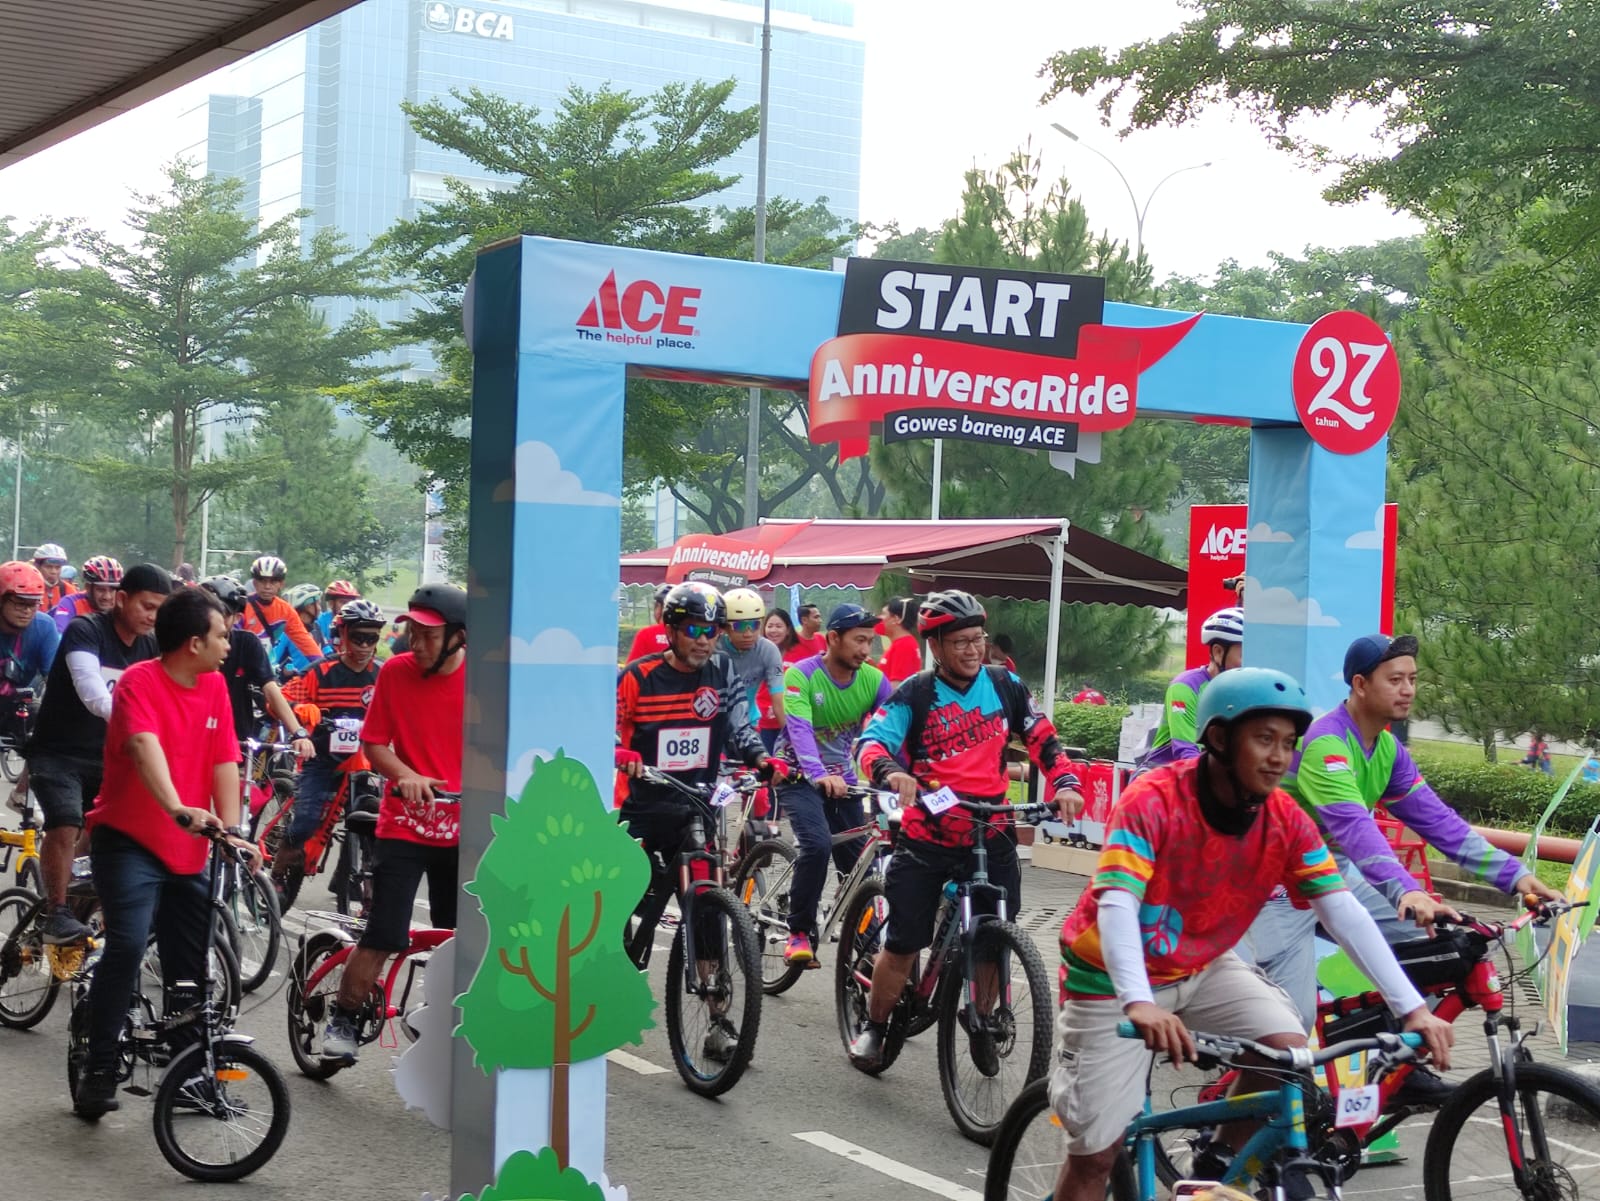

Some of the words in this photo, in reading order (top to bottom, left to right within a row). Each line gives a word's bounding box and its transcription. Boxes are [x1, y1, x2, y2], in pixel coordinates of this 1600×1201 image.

[454, 7, 514, 41] BCA
[575, 267, 702, 336] ACE
[876, 270, 1071, 338] START
[576, 328, 602, 341] The
[606, 331, 652, 346] helpful
[656, 337, 696, 349] place.
[819, 353, 1129, 415] AnniversaRide
[1307, 336, 1388, 431] 27
[894, 415, 957, 435] Gowes
[961, 414, 1025, 445] bareng
[1028, 425, 1066, 446] ACE
[1315, 416, 1339, 428] tahun
[1199, 522, 1248, 555] ACE
[671, 542, 771, 571] AnniversaRide
[666, 738, 700, 757] 088
[1344, 1096, 1371, 1113] 067
